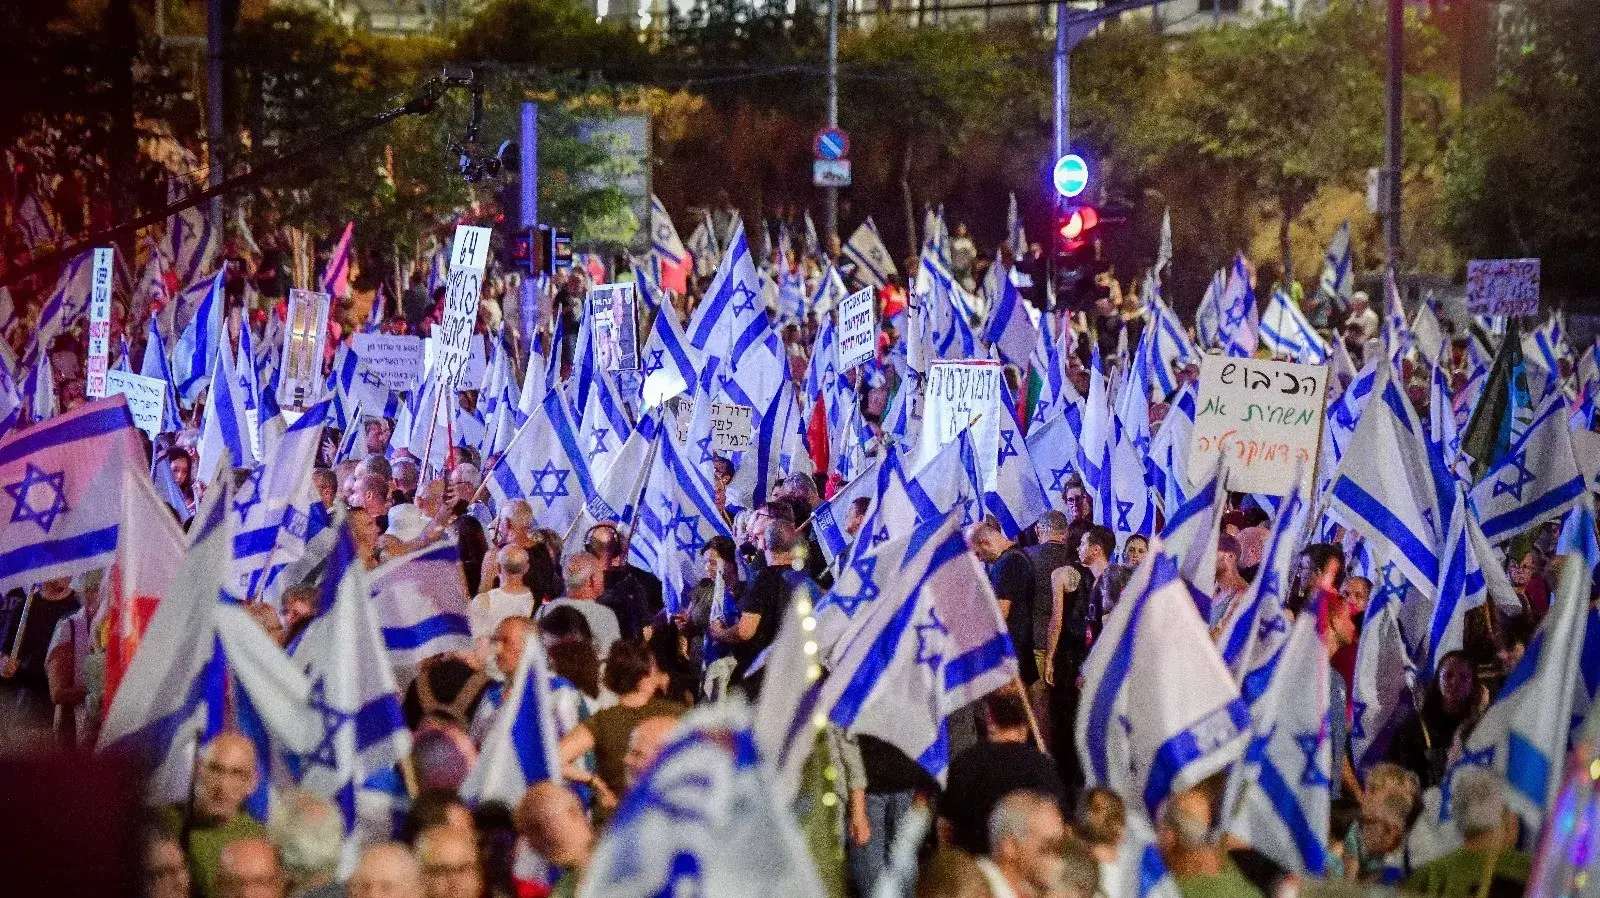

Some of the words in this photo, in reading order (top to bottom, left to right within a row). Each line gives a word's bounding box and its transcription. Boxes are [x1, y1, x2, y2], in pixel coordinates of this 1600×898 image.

[459, 229, 479, 266] 64
[1220, 363, 1317, 397] הכיבוש
[725, 405, 751, 418] דור
[1197, 395, 1227, 417] את
[1240, 404, 1315, 426] משחית
[716, 433, 750, 447] תמיד
